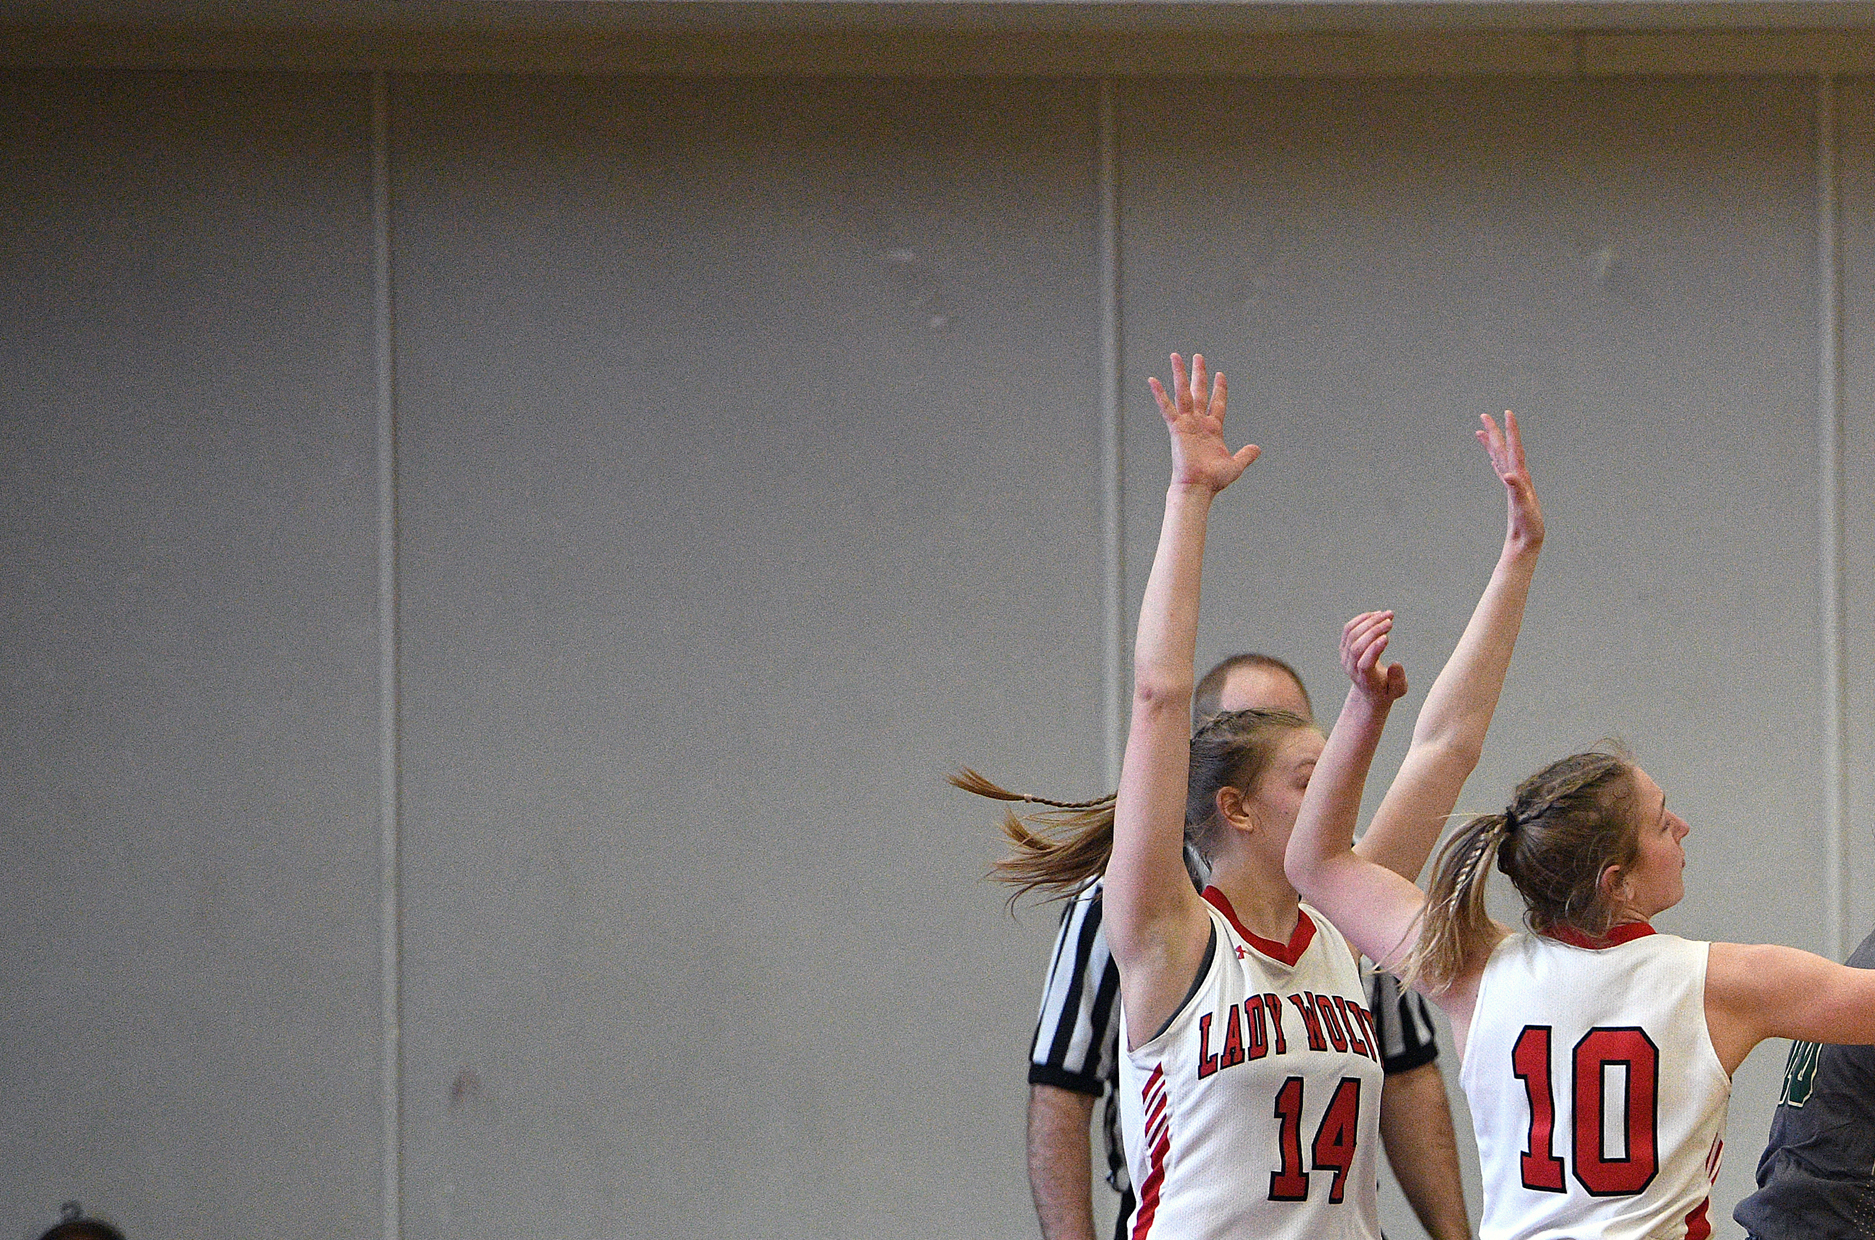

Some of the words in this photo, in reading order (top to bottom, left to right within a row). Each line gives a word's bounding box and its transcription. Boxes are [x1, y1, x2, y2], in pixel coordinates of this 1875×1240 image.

[1198, 993, 1288, 1080] LADY
[1267, 1076, 1362, 1204] 14
[1511, 1024, 1659, 1197] 10
